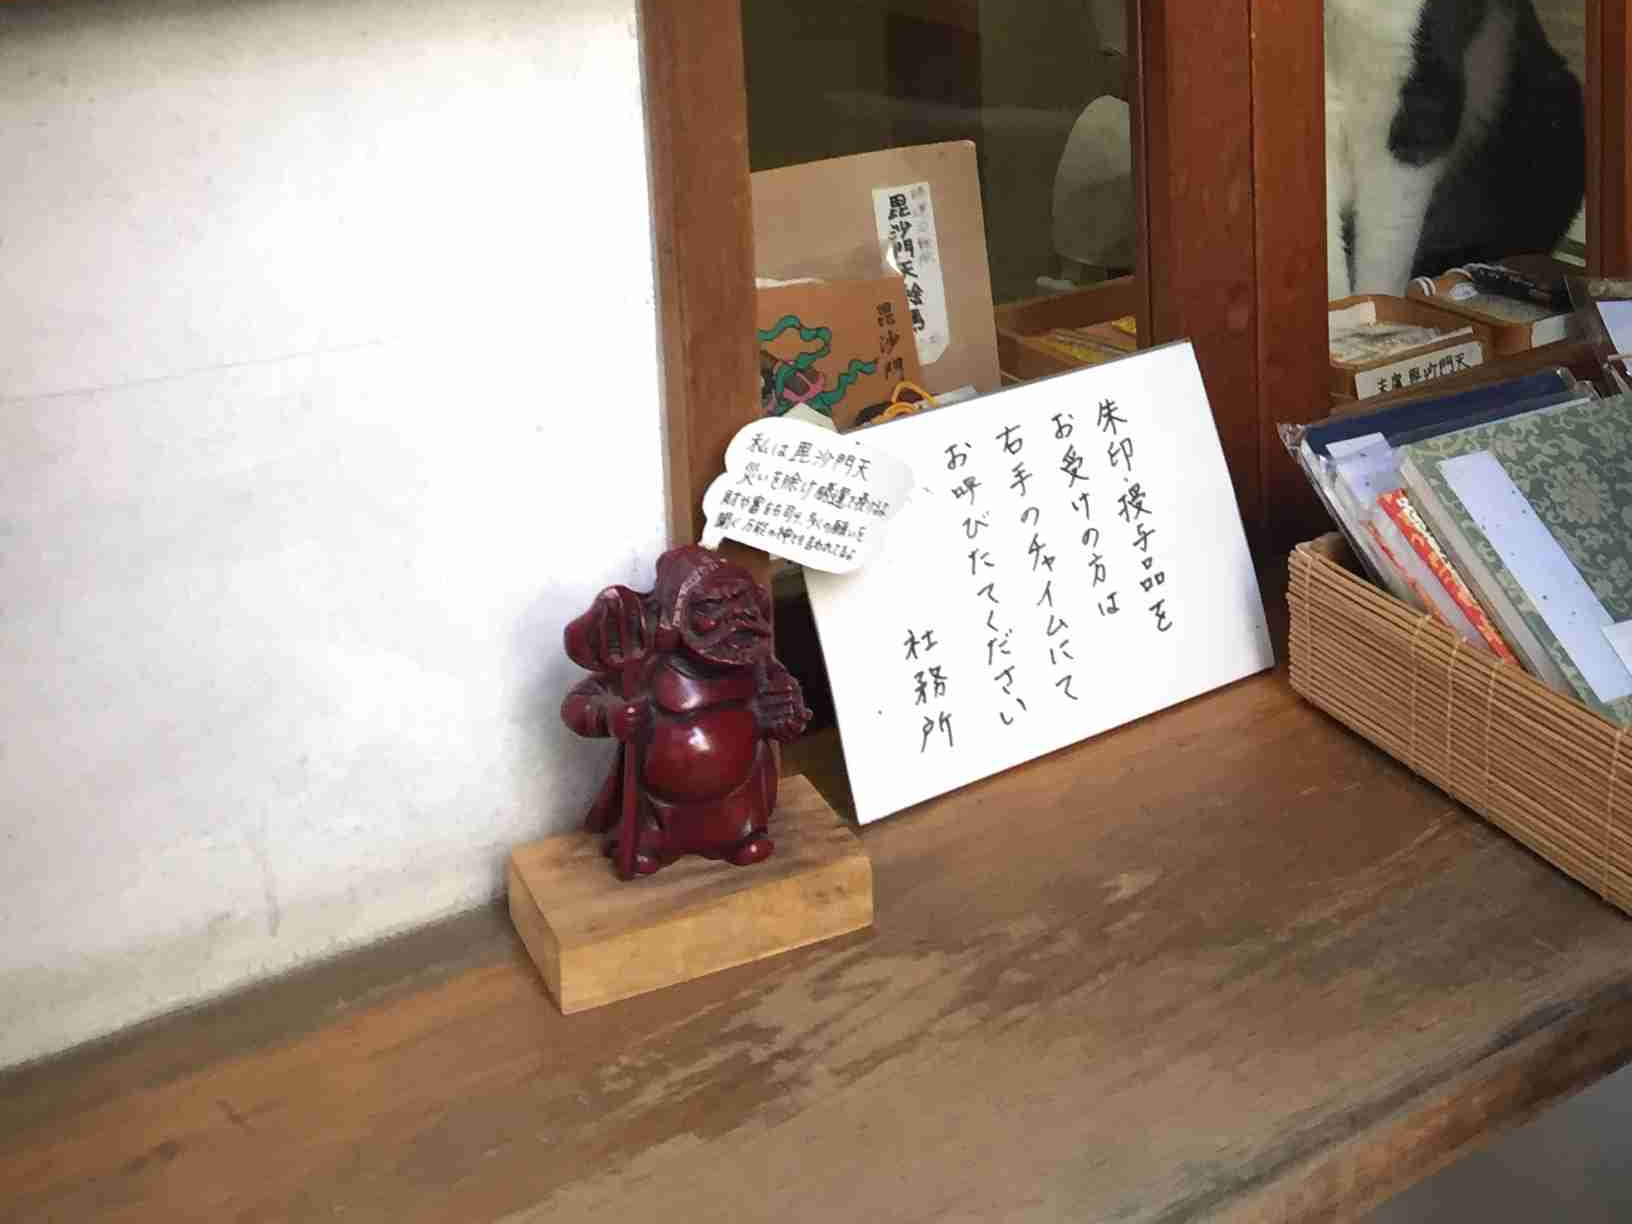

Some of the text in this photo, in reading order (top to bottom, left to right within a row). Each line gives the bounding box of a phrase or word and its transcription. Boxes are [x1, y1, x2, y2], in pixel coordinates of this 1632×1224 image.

[943, 442, 1029, 727] お呼びたてください
[996, 424, 1079, 701] 右手のチャイムにて
[1052, 411, 1120, 616] お受けの方は
[903, 628, 956, 753] 社務所
